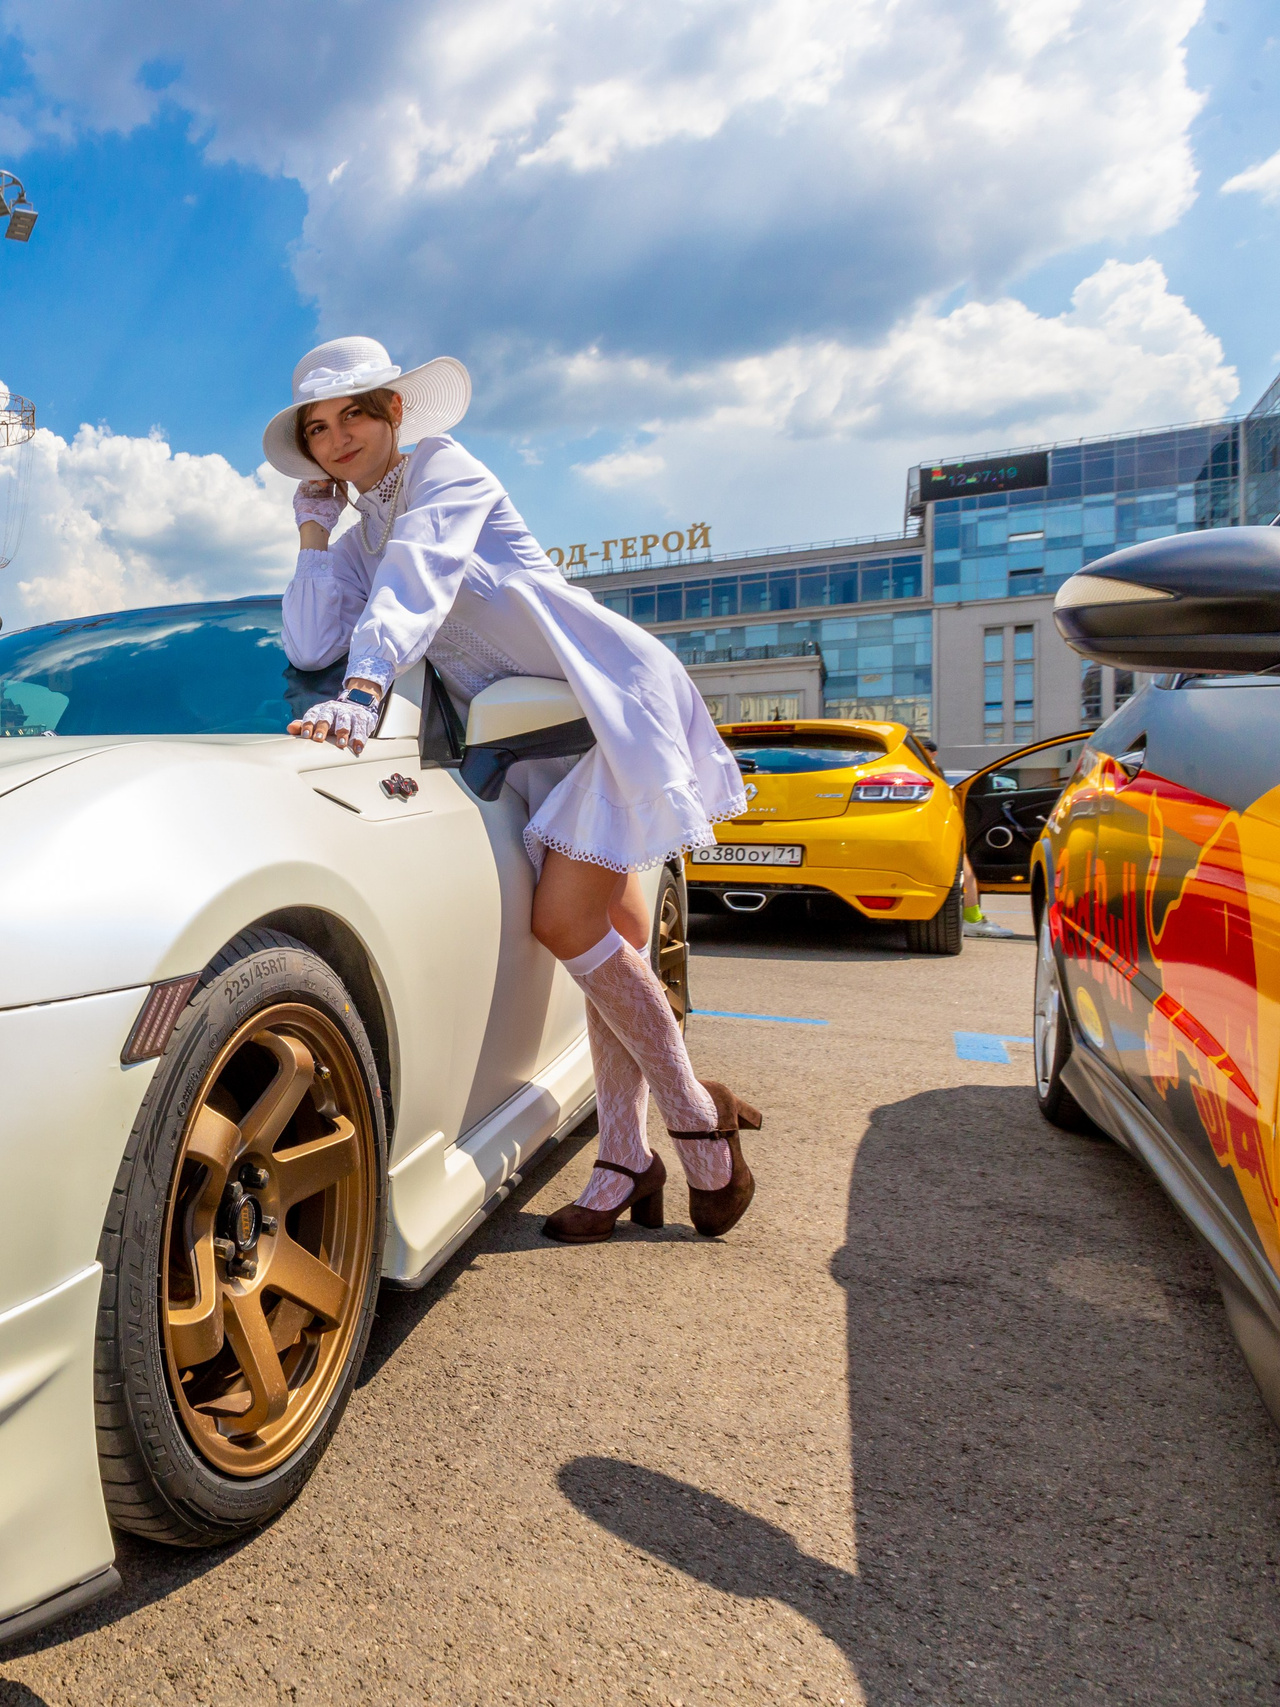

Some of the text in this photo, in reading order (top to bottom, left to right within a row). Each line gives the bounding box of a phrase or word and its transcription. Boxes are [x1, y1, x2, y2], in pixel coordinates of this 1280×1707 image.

[777, 847, 797, 859] 71
[224, 956, 288, 1005] 225/45R17
[126, 1210, 168, 1464] TRIANGLE
